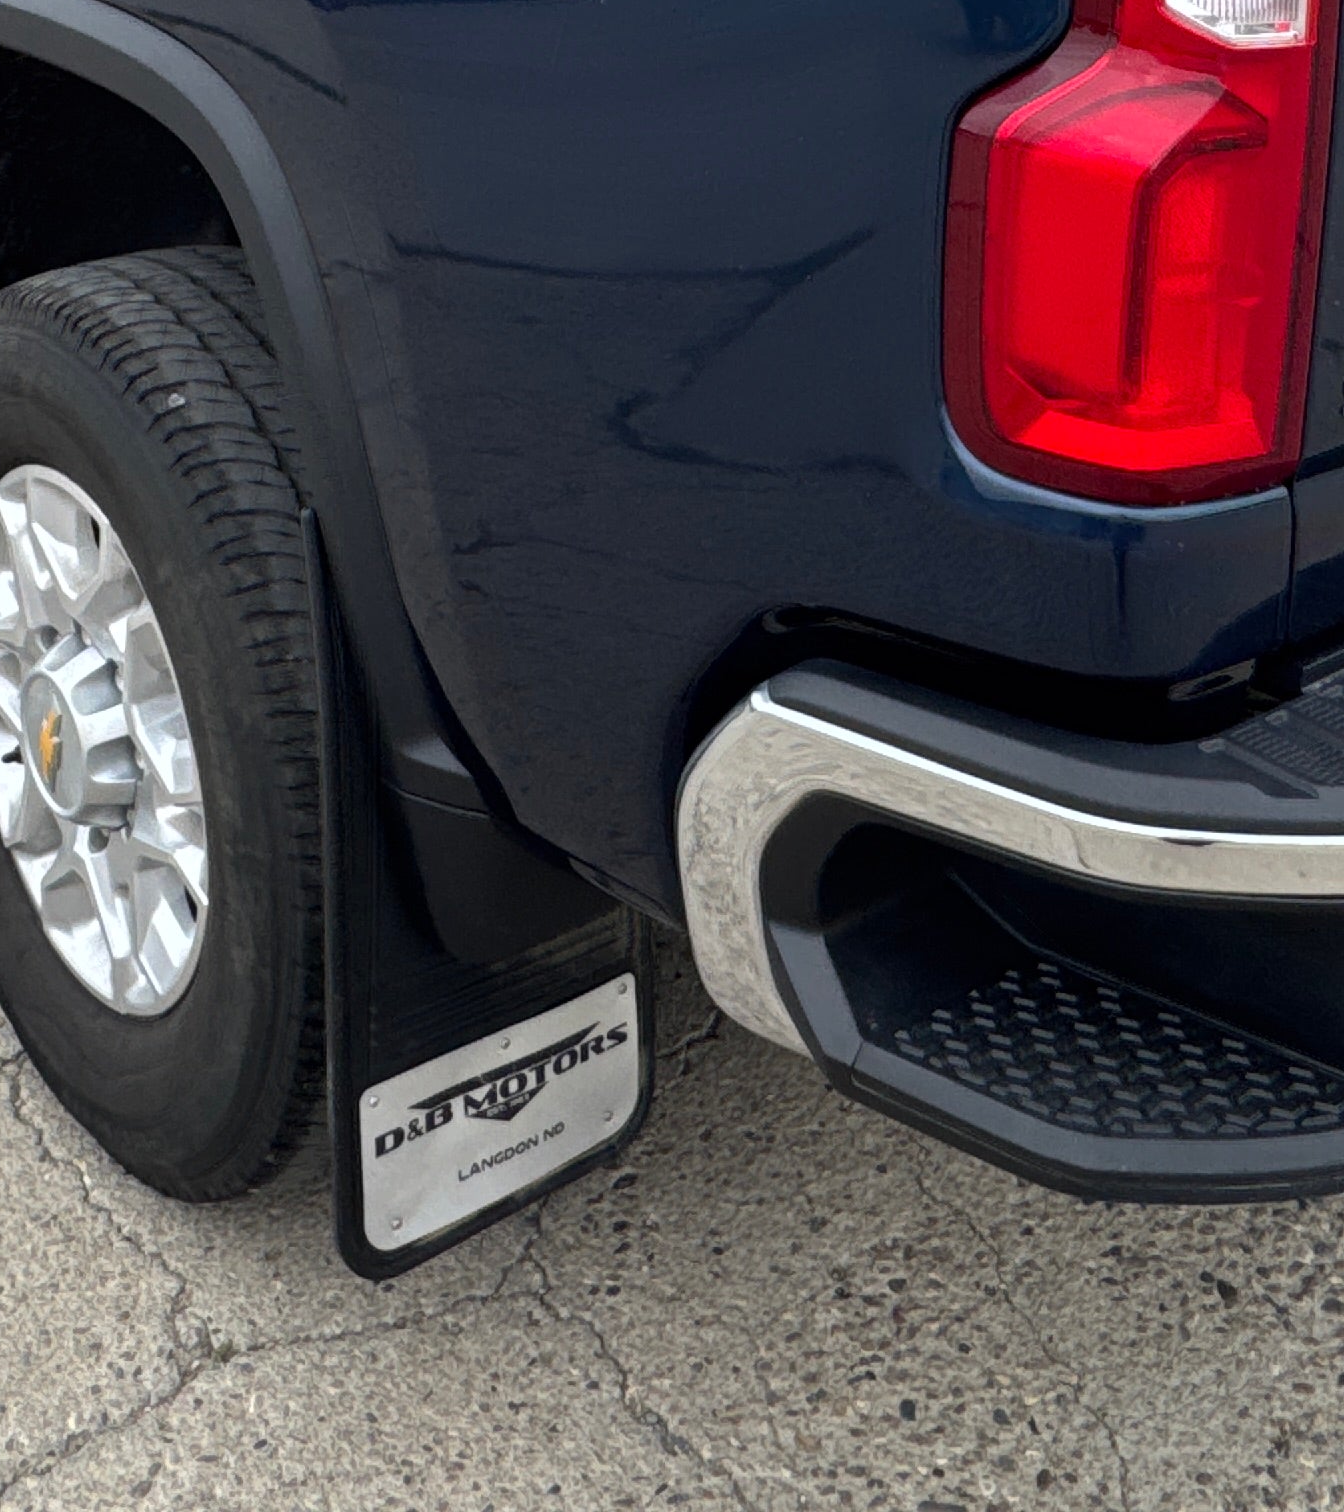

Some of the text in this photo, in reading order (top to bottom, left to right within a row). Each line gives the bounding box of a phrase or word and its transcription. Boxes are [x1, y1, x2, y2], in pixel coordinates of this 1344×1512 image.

[374, 1021, 628, 1159] D&B MOTORS
[457, 1120, 566, 1182] LANGDON ND
